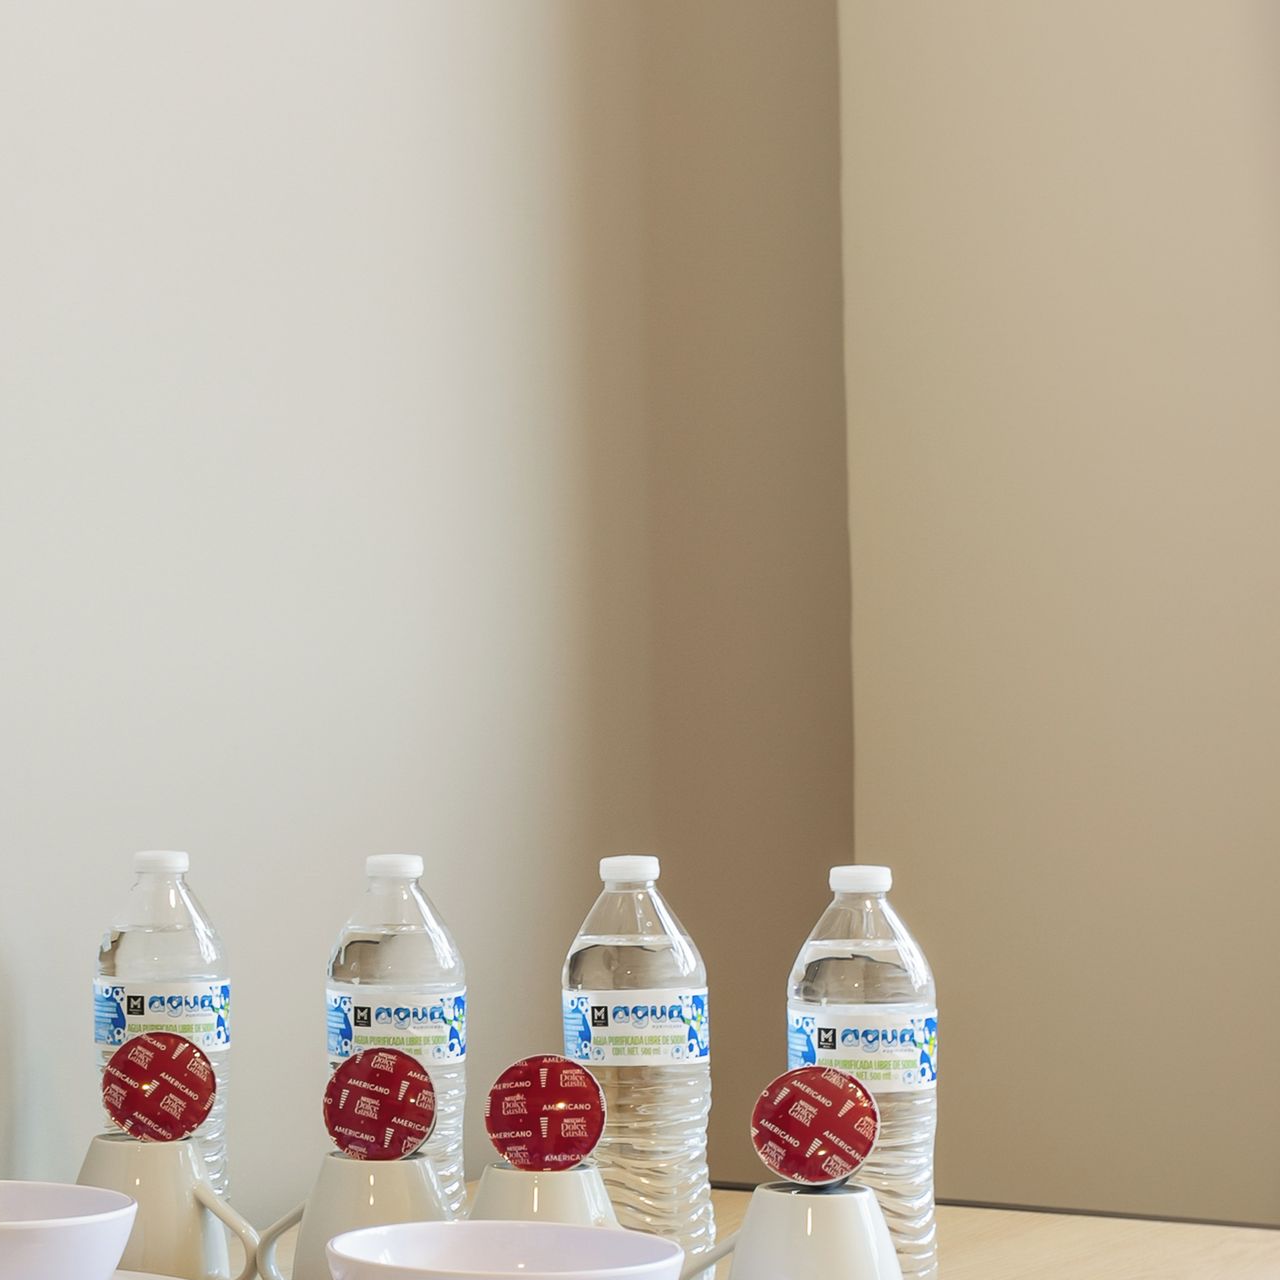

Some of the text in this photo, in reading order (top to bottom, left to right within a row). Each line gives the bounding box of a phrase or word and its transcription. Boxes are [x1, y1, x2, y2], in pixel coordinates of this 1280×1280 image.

[148, 995, 213, 1018] agua
[375, 1006, 444, 1030] agua
[612, 1005, 682, 1029] agua
[841, 1028, 916, 1053] agua
[160, 1072, 199, 1100] AMERICANO
[348, 1078, 390, 1095] AMERICANO
[791, 1080, 832, 1107] AMERICANO
[133, 1111, 172, 1140] AMERICANO
[334, 1125, 376, 1143] AMERICANO
[760, 1119, 800, 1147] AMERICANO
